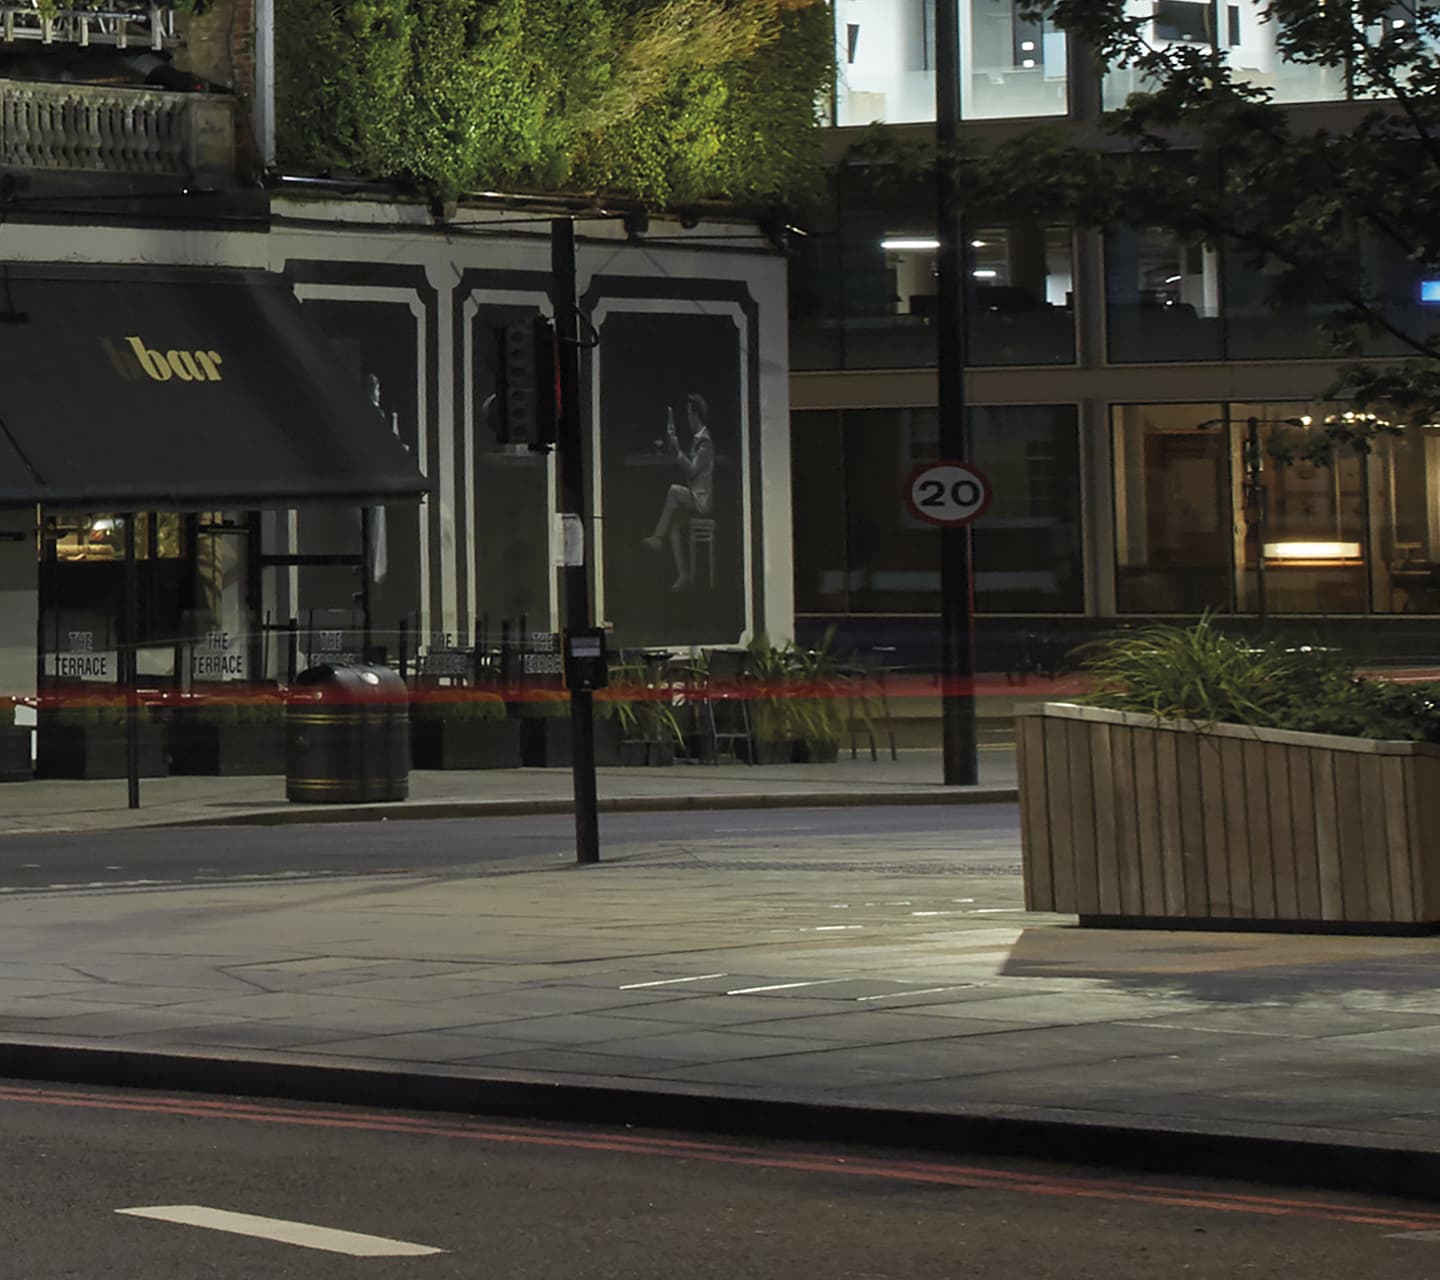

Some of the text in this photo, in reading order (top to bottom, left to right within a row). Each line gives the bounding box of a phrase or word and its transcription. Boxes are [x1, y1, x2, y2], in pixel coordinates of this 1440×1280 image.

[919, 480, 980, 507] 20
[207, 631, 229, 650] THE
[54, 656, 108, 676] TERRACE
[193, 655, 243, 674] TERRACE
